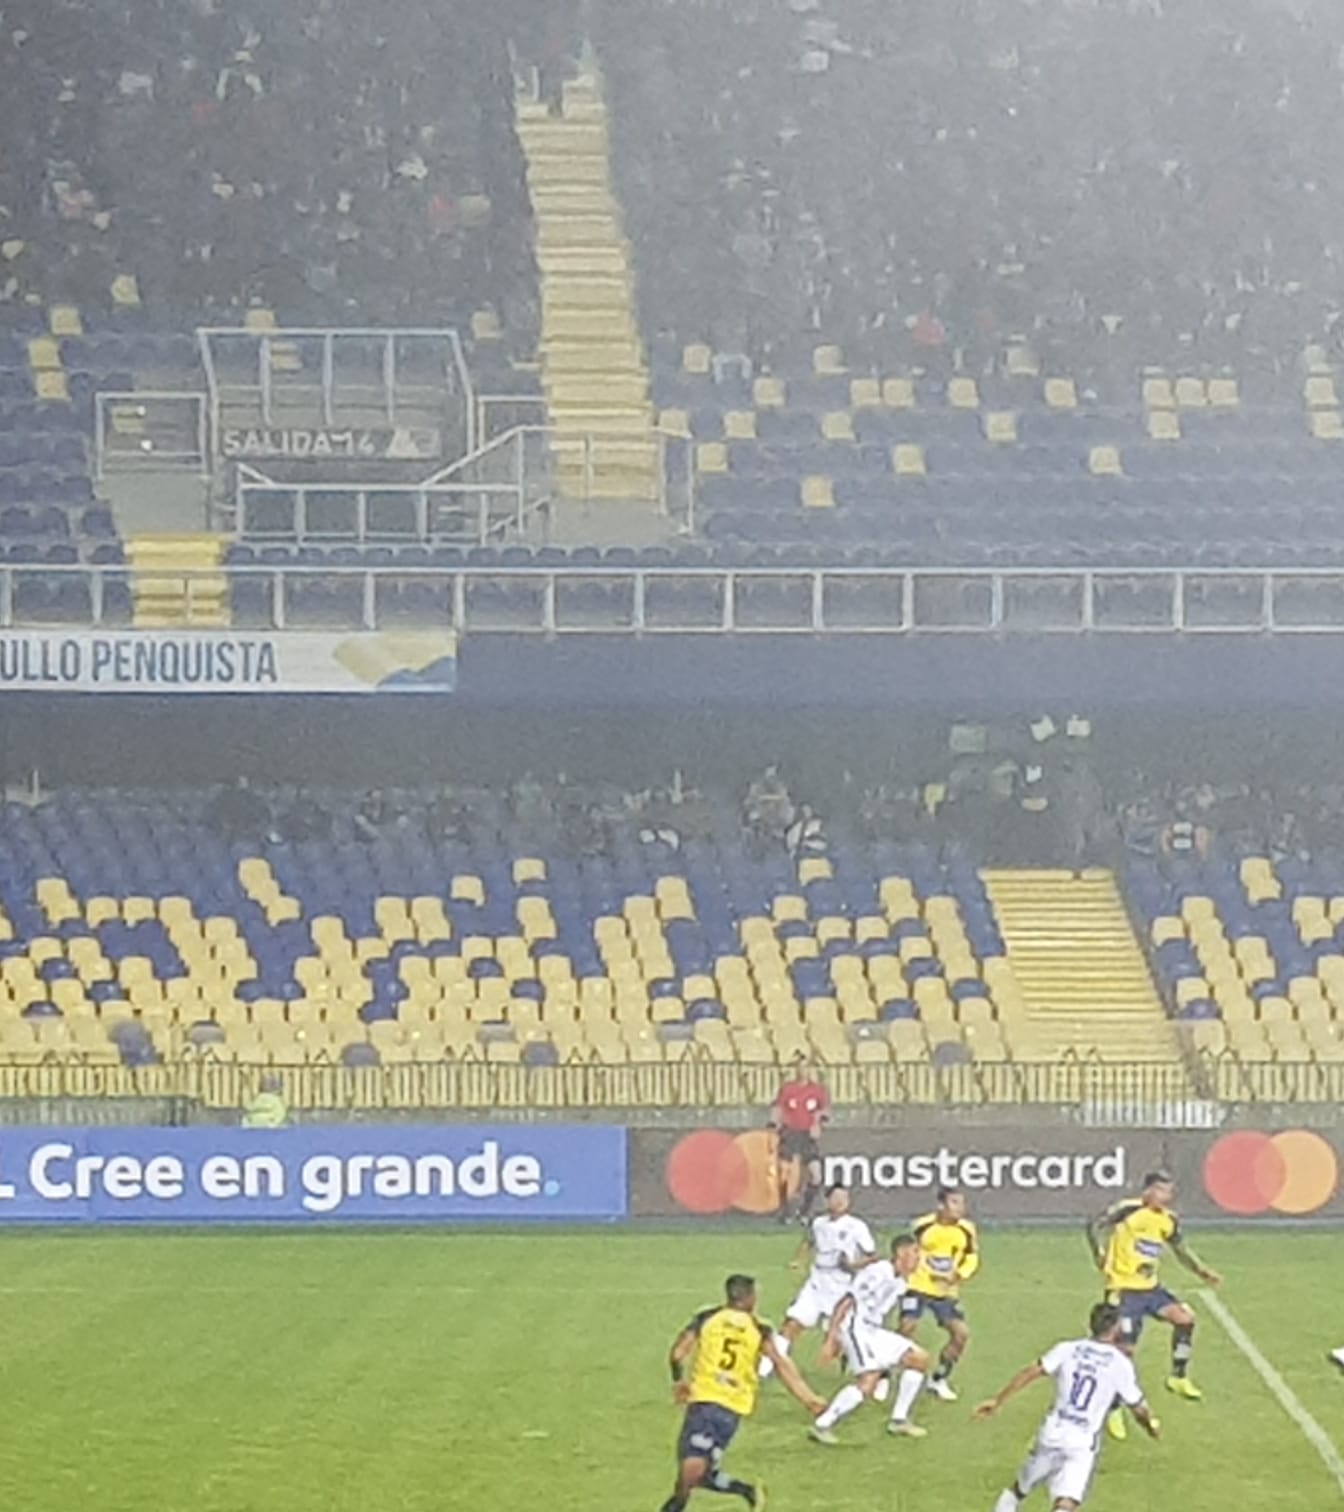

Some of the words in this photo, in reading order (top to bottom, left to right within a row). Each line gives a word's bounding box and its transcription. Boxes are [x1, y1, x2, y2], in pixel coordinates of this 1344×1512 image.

[223, 430, 332, 458] SALIDA
[92, 640, 278, 684] PENQUISTA
[28, 1143, 183, 1199] Cree
[201, 1153, 285, 1198] en
[824, 1146, 1126, 1189] mastercard
[718, 1337, 742, 1371] 5
[1069, 1371, 1097, 1412] 10
